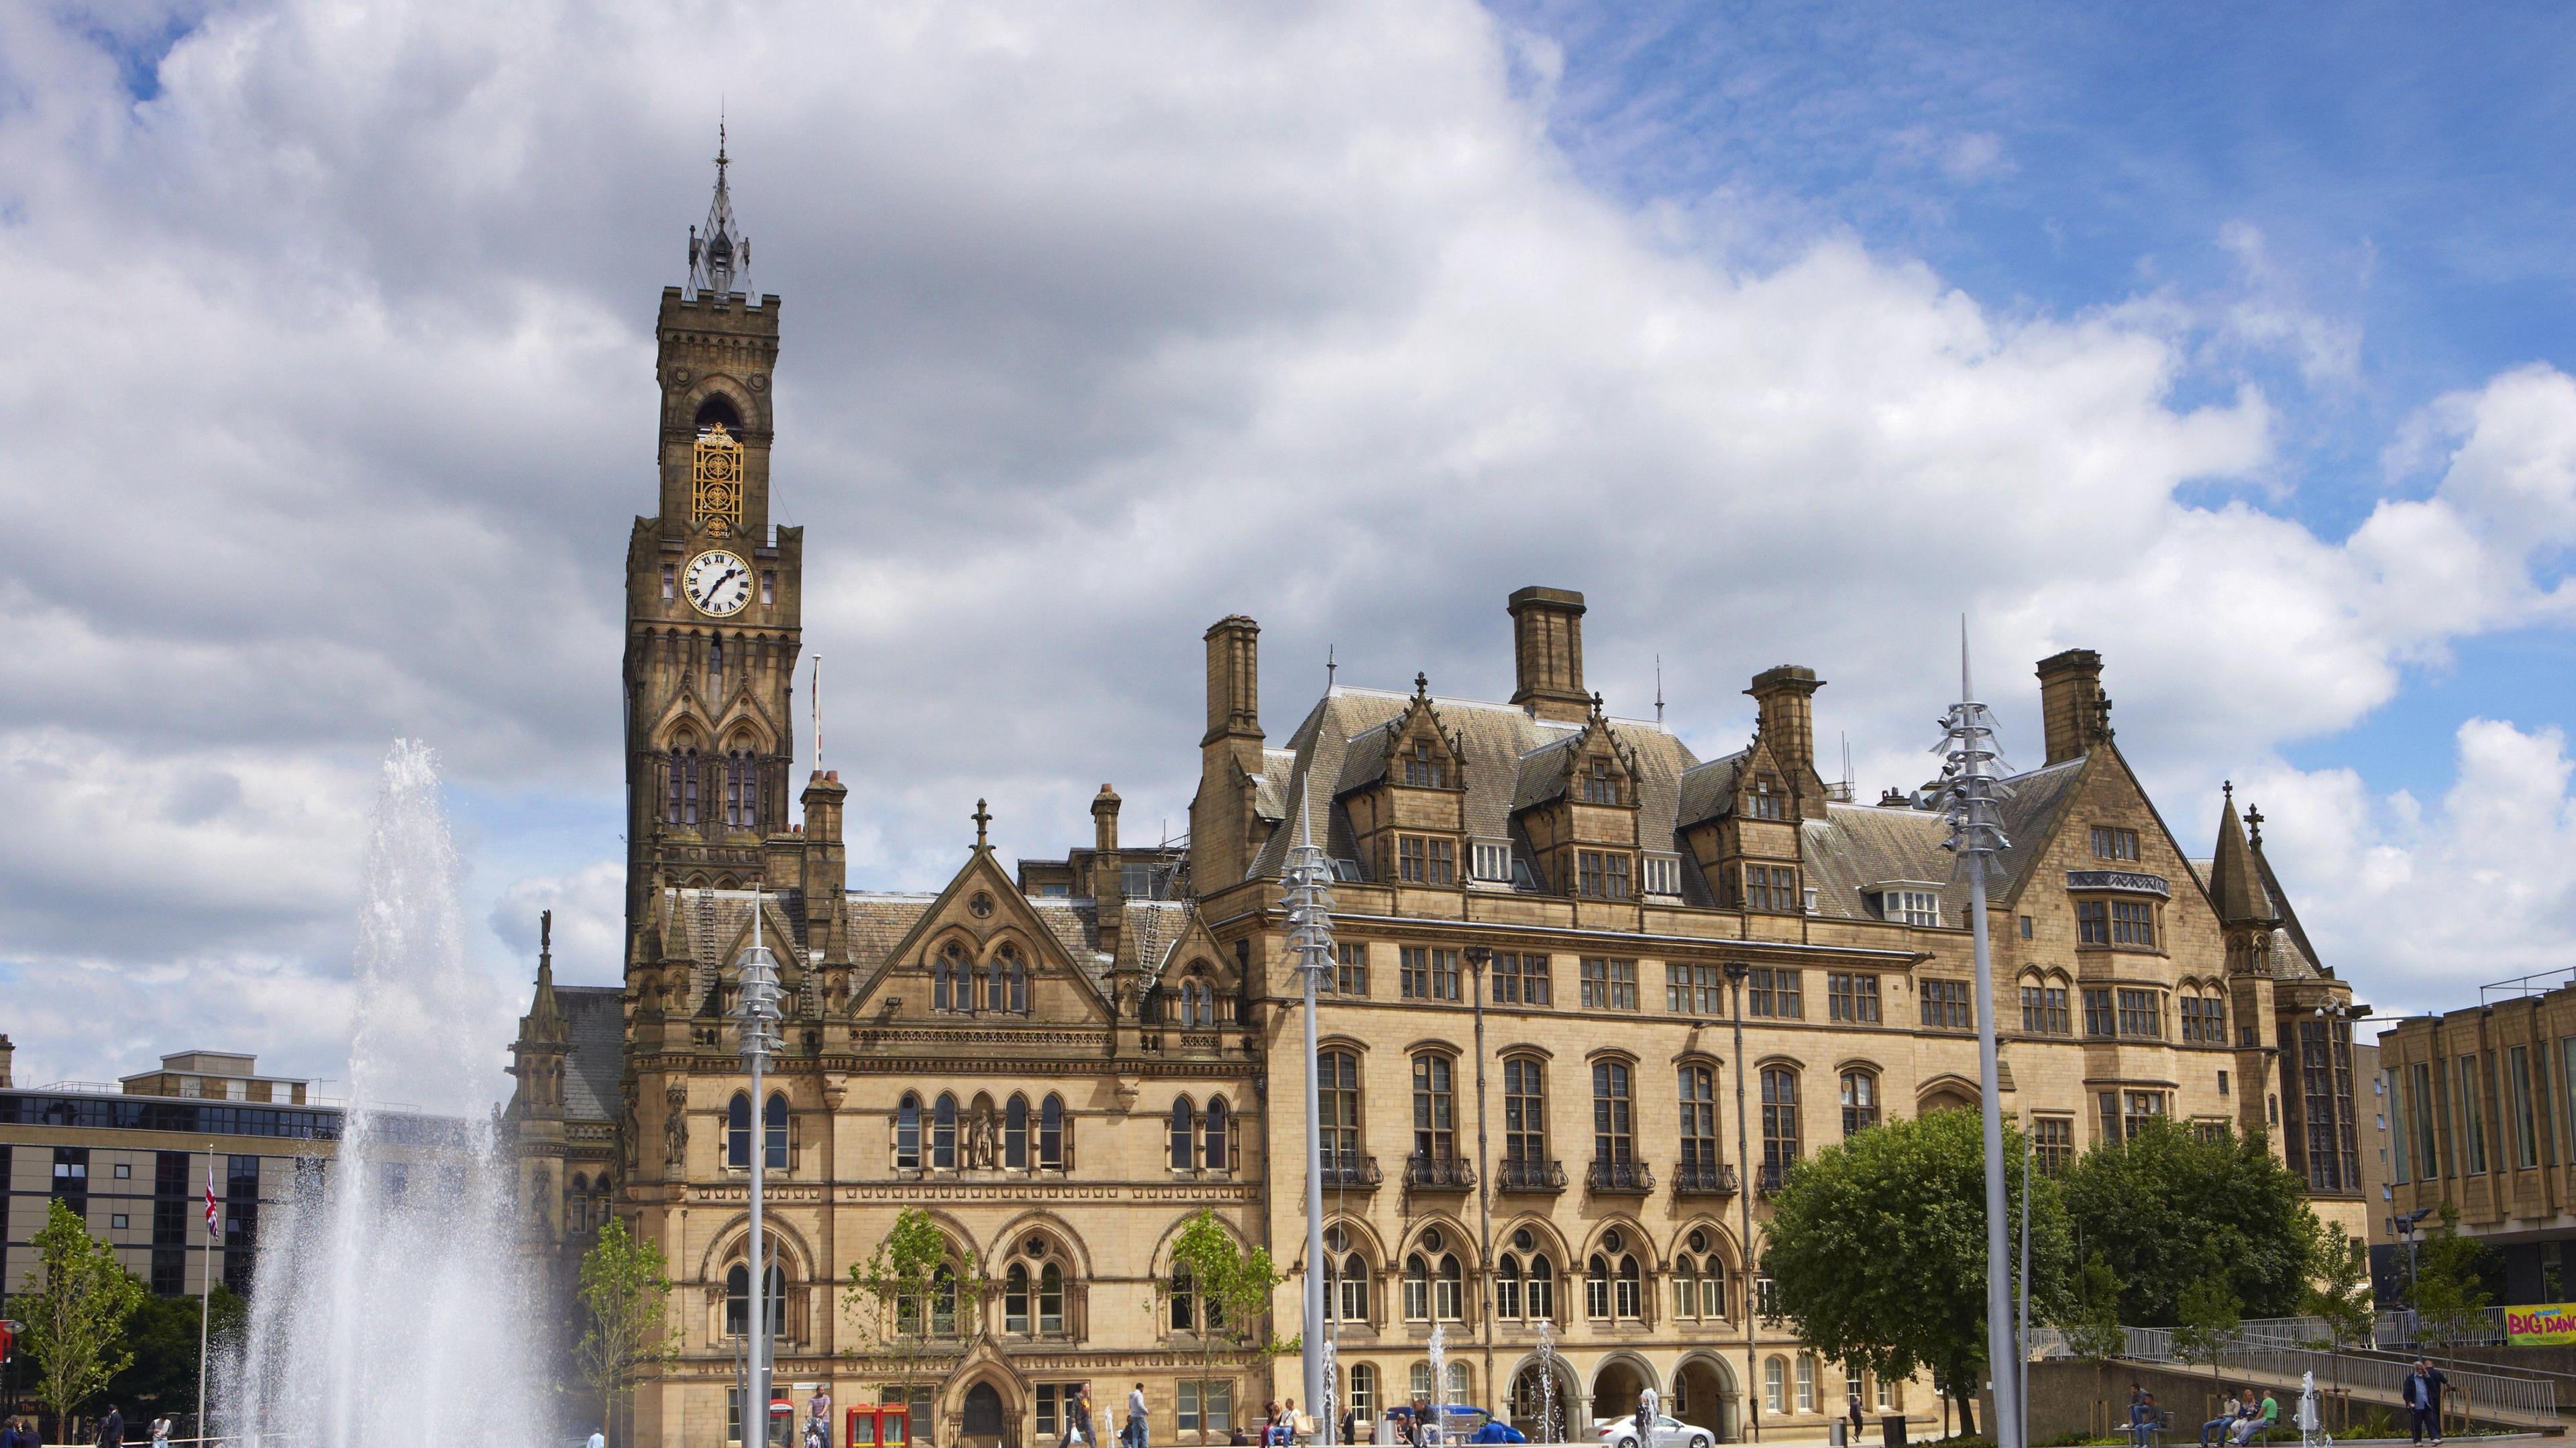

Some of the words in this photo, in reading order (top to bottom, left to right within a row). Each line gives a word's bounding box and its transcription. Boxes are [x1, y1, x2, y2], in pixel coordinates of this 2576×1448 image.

[702, 556, 711, 566] XI
[714, 555, 724, 563] XII
[692, 566, 701, 574] X
[729, 602, 736, 610] V
[2508, 1313, 2542, 1335] BIG
